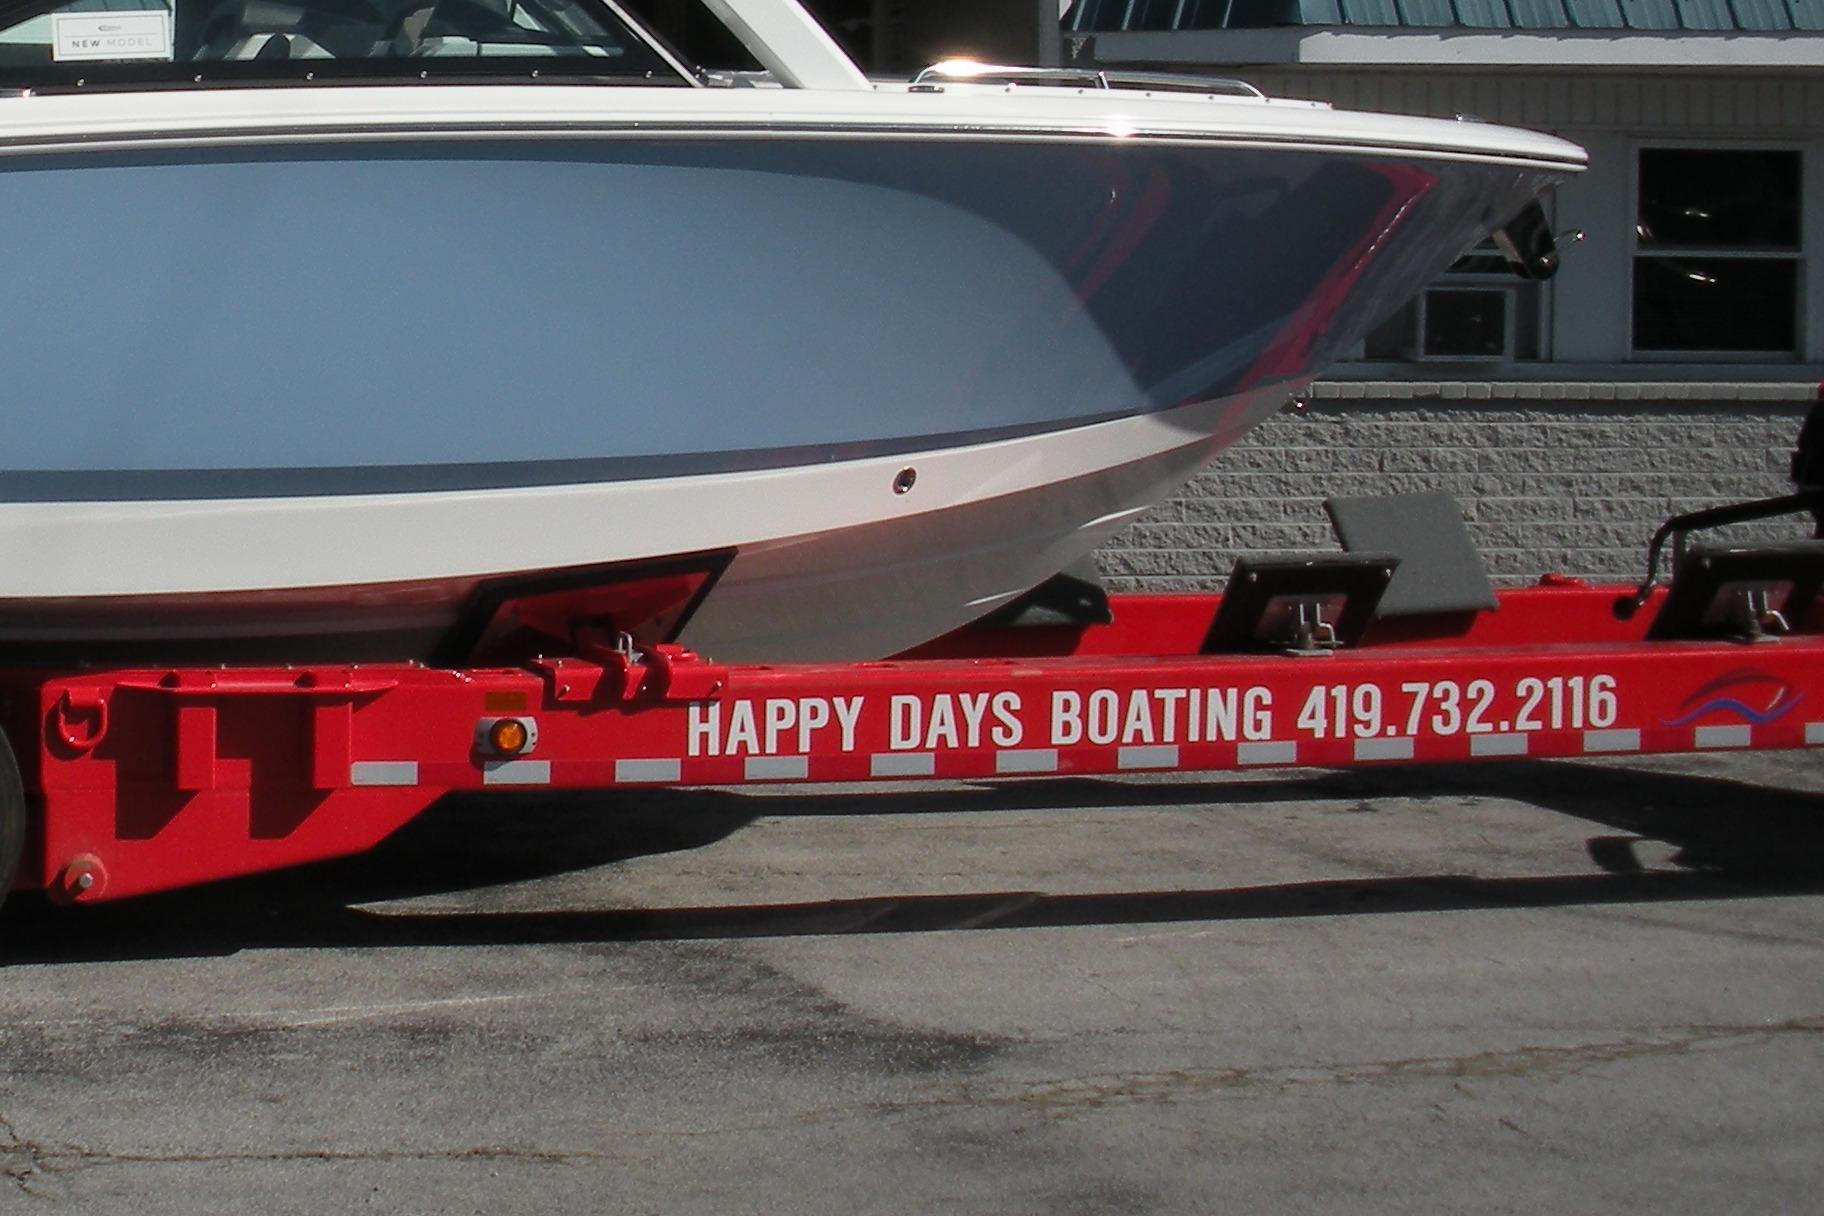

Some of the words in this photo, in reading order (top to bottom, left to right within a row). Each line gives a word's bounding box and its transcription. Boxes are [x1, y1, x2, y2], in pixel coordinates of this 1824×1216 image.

[71, 39, 101, 49] NEW
[106, 37, 153, 48] MODEL
[687, 695, 865, 757] HAPPY
[889, 691, 1024, 750] DAYS
[1050, 685, 1274, 746] BOATING
[1296, 673, 1618, 739] 419.732.2116
